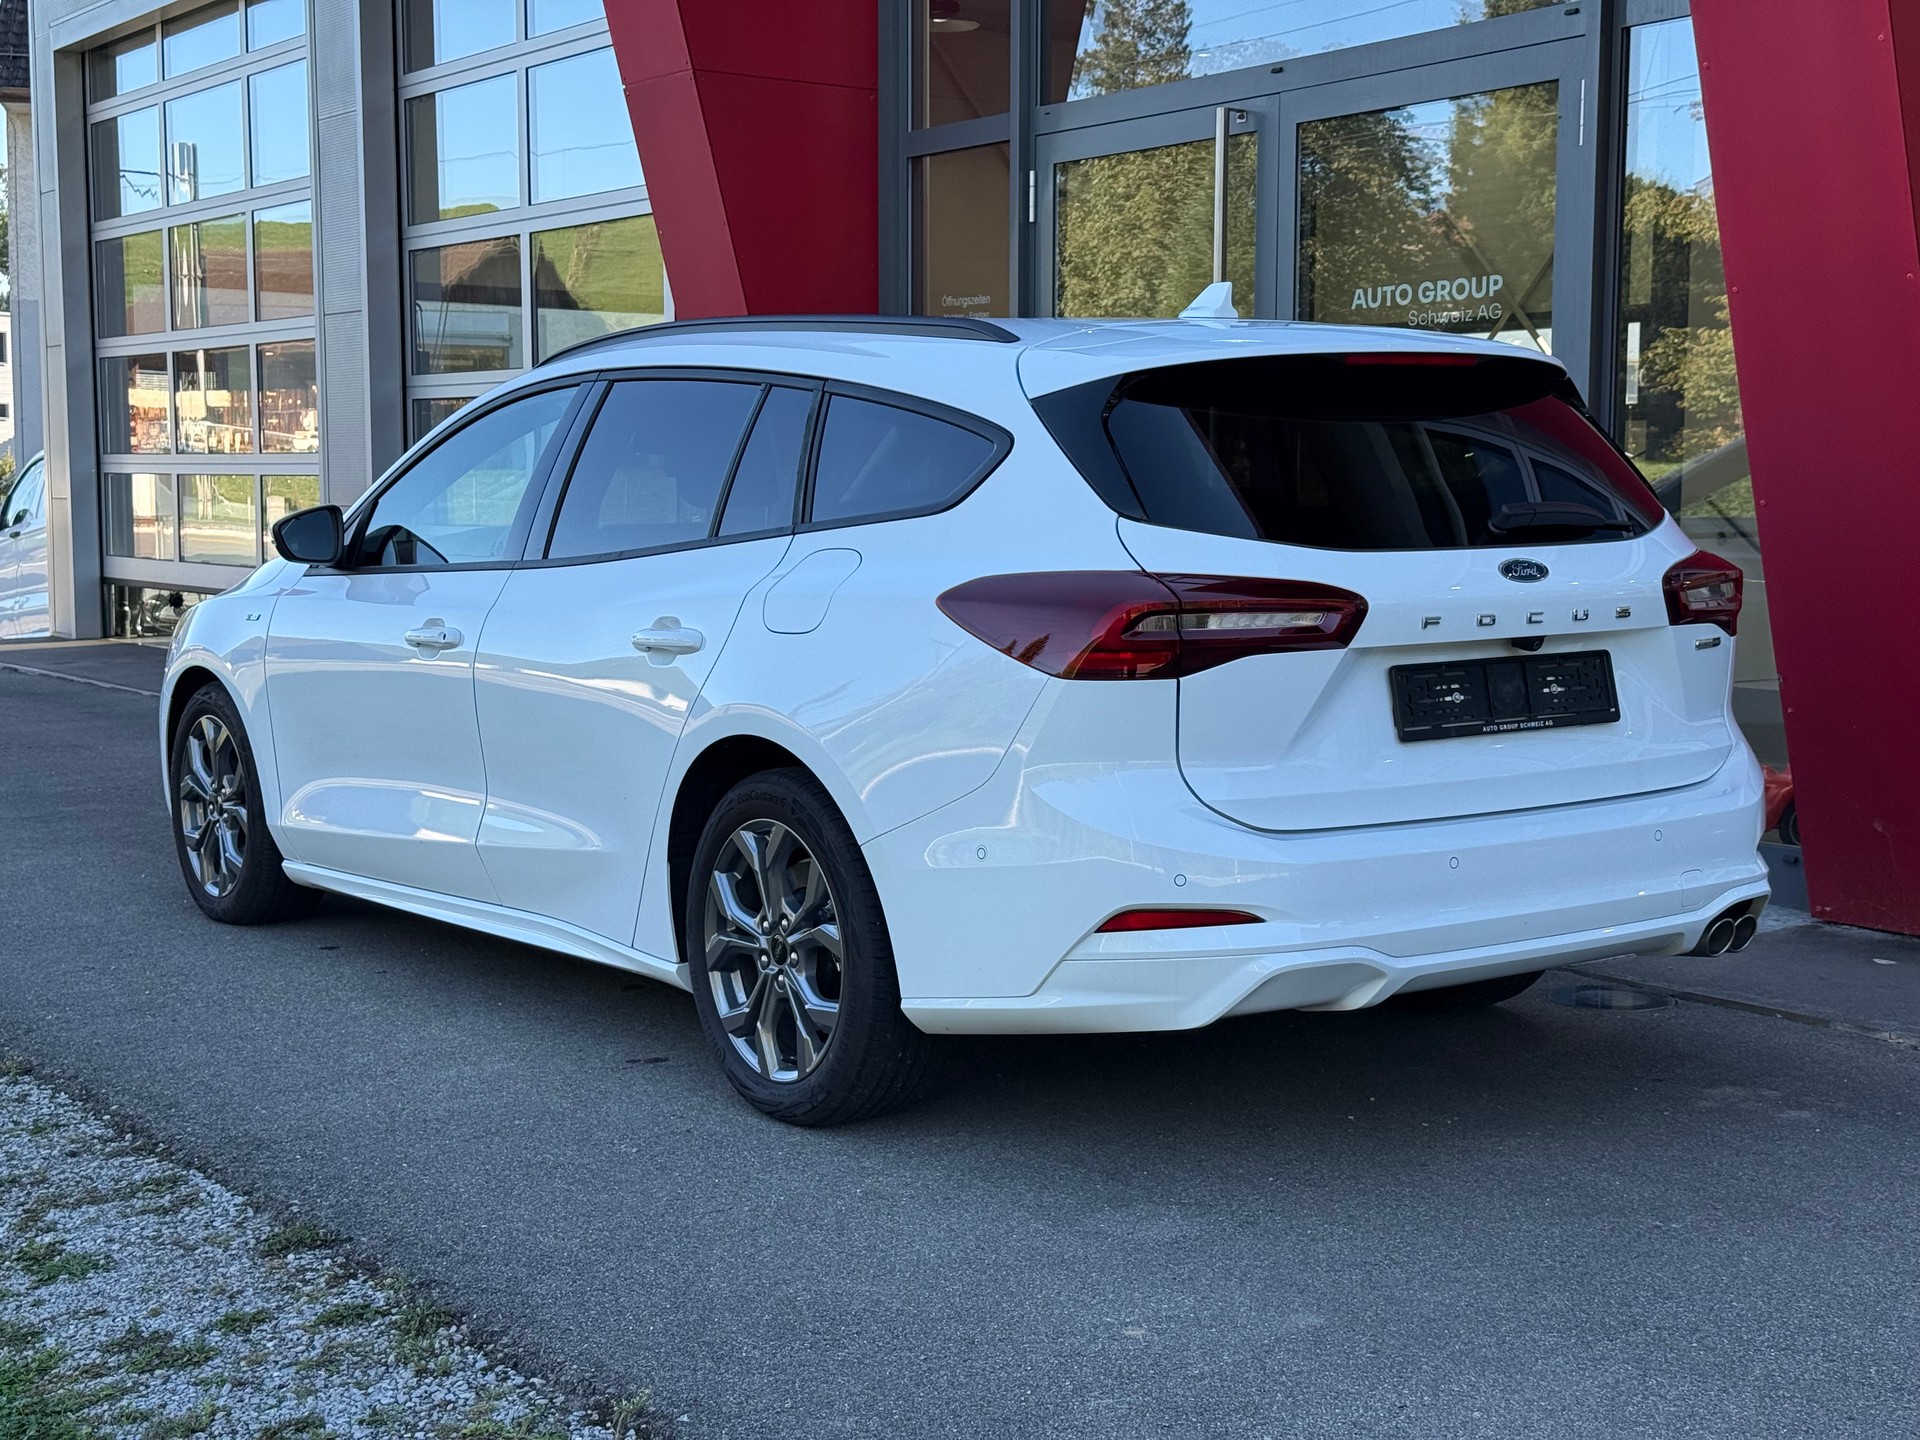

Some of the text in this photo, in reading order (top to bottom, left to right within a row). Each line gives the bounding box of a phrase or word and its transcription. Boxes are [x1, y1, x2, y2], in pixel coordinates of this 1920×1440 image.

[941, 294, 991, 308] Öffnungszeiten
[1351, 274, 1503, 310] AUTO GROUP
[1407, 302, 1502, 327] Schweiz AG
[1421, 606, 1632, 630] FOCUS
[1499, 723, 1518, 731] GROUP
[1520, 721, 1544, 729] SCHWEIZ
